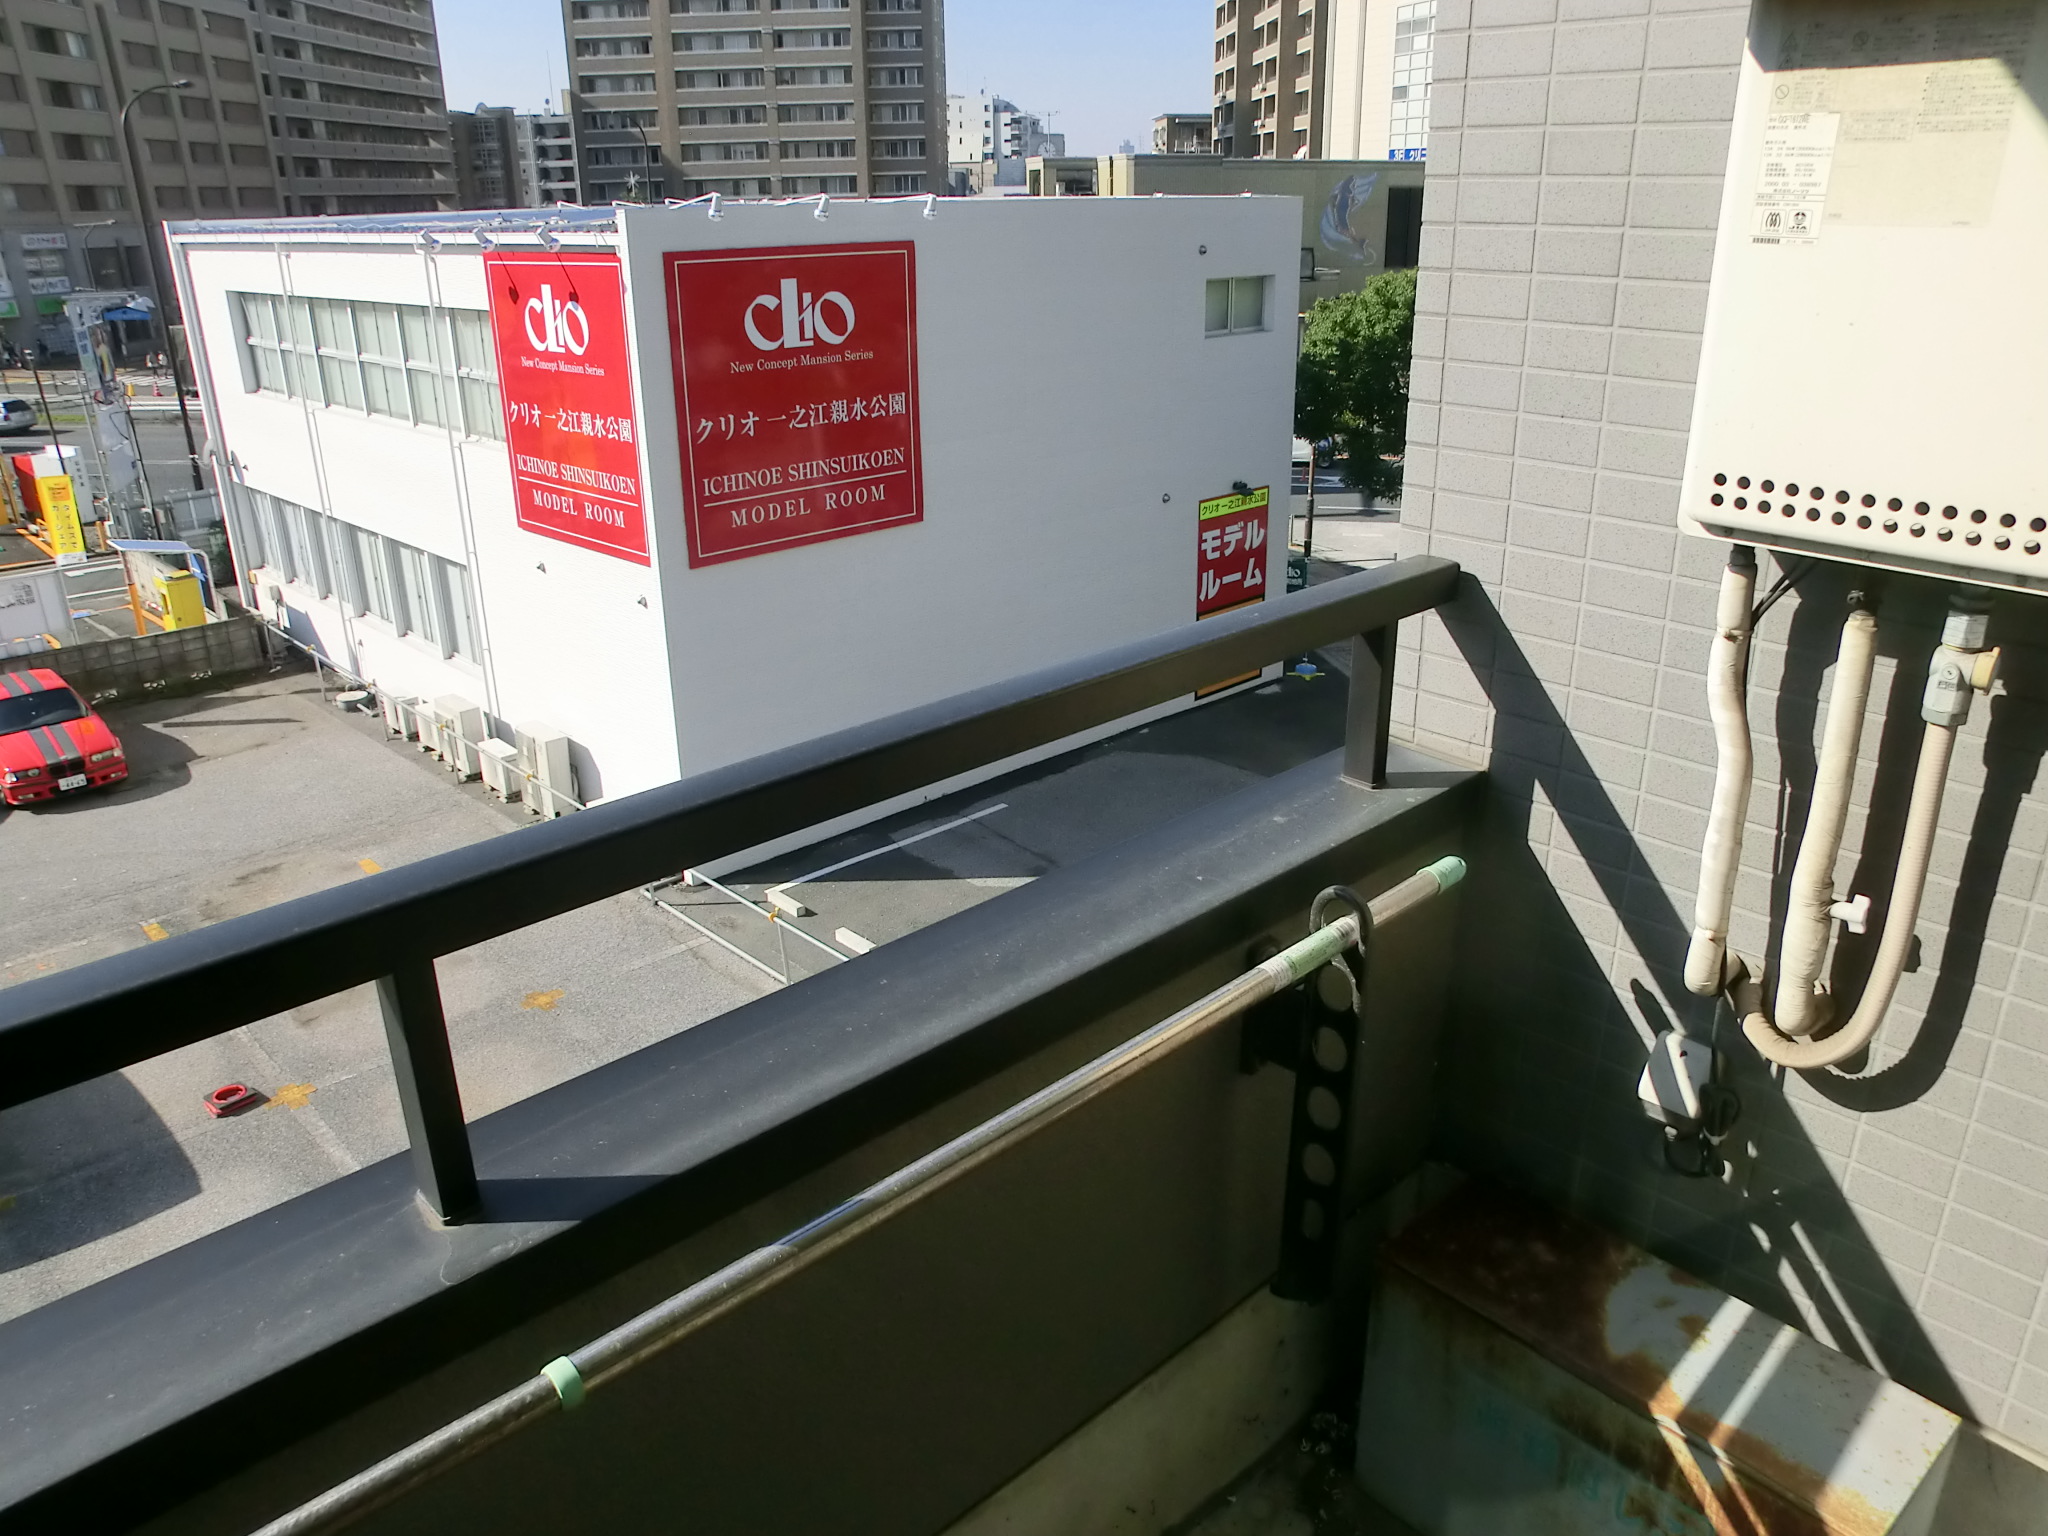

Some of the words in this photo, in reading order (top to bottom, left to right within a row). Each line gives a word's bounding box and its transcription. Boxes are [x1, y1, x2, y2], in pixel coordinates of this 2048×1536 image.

[521, 356, 534, 368] New
[535, 357, 557, 374] Concept
[558, 360, 583, 375] Mansion
[584, 364, 605, 376] Series
[730, 361, 754, 374] New
[757, 357, 798, 373] Concept
[800, 353, 842, 366] Mansion
[844, 349, 874, 361] Series
[516, 454, 560, 480] ICHINOE
[561, 463, 636, 496] SHINSUIKOEN
[703, 467, 784, 497] ICHINOE
[788, 447, 906, 483] SHINSUIKOEN
[533, 490, 578, 515] MODEL
[584, 503, 627, 528] ROOM
[731, 497, 811, 528] MODEL
[825, 483, 886, 511] ROOM
[1201, 519, 1265, 560] モデル
[1199, 557, 1263, 602] ルーム
